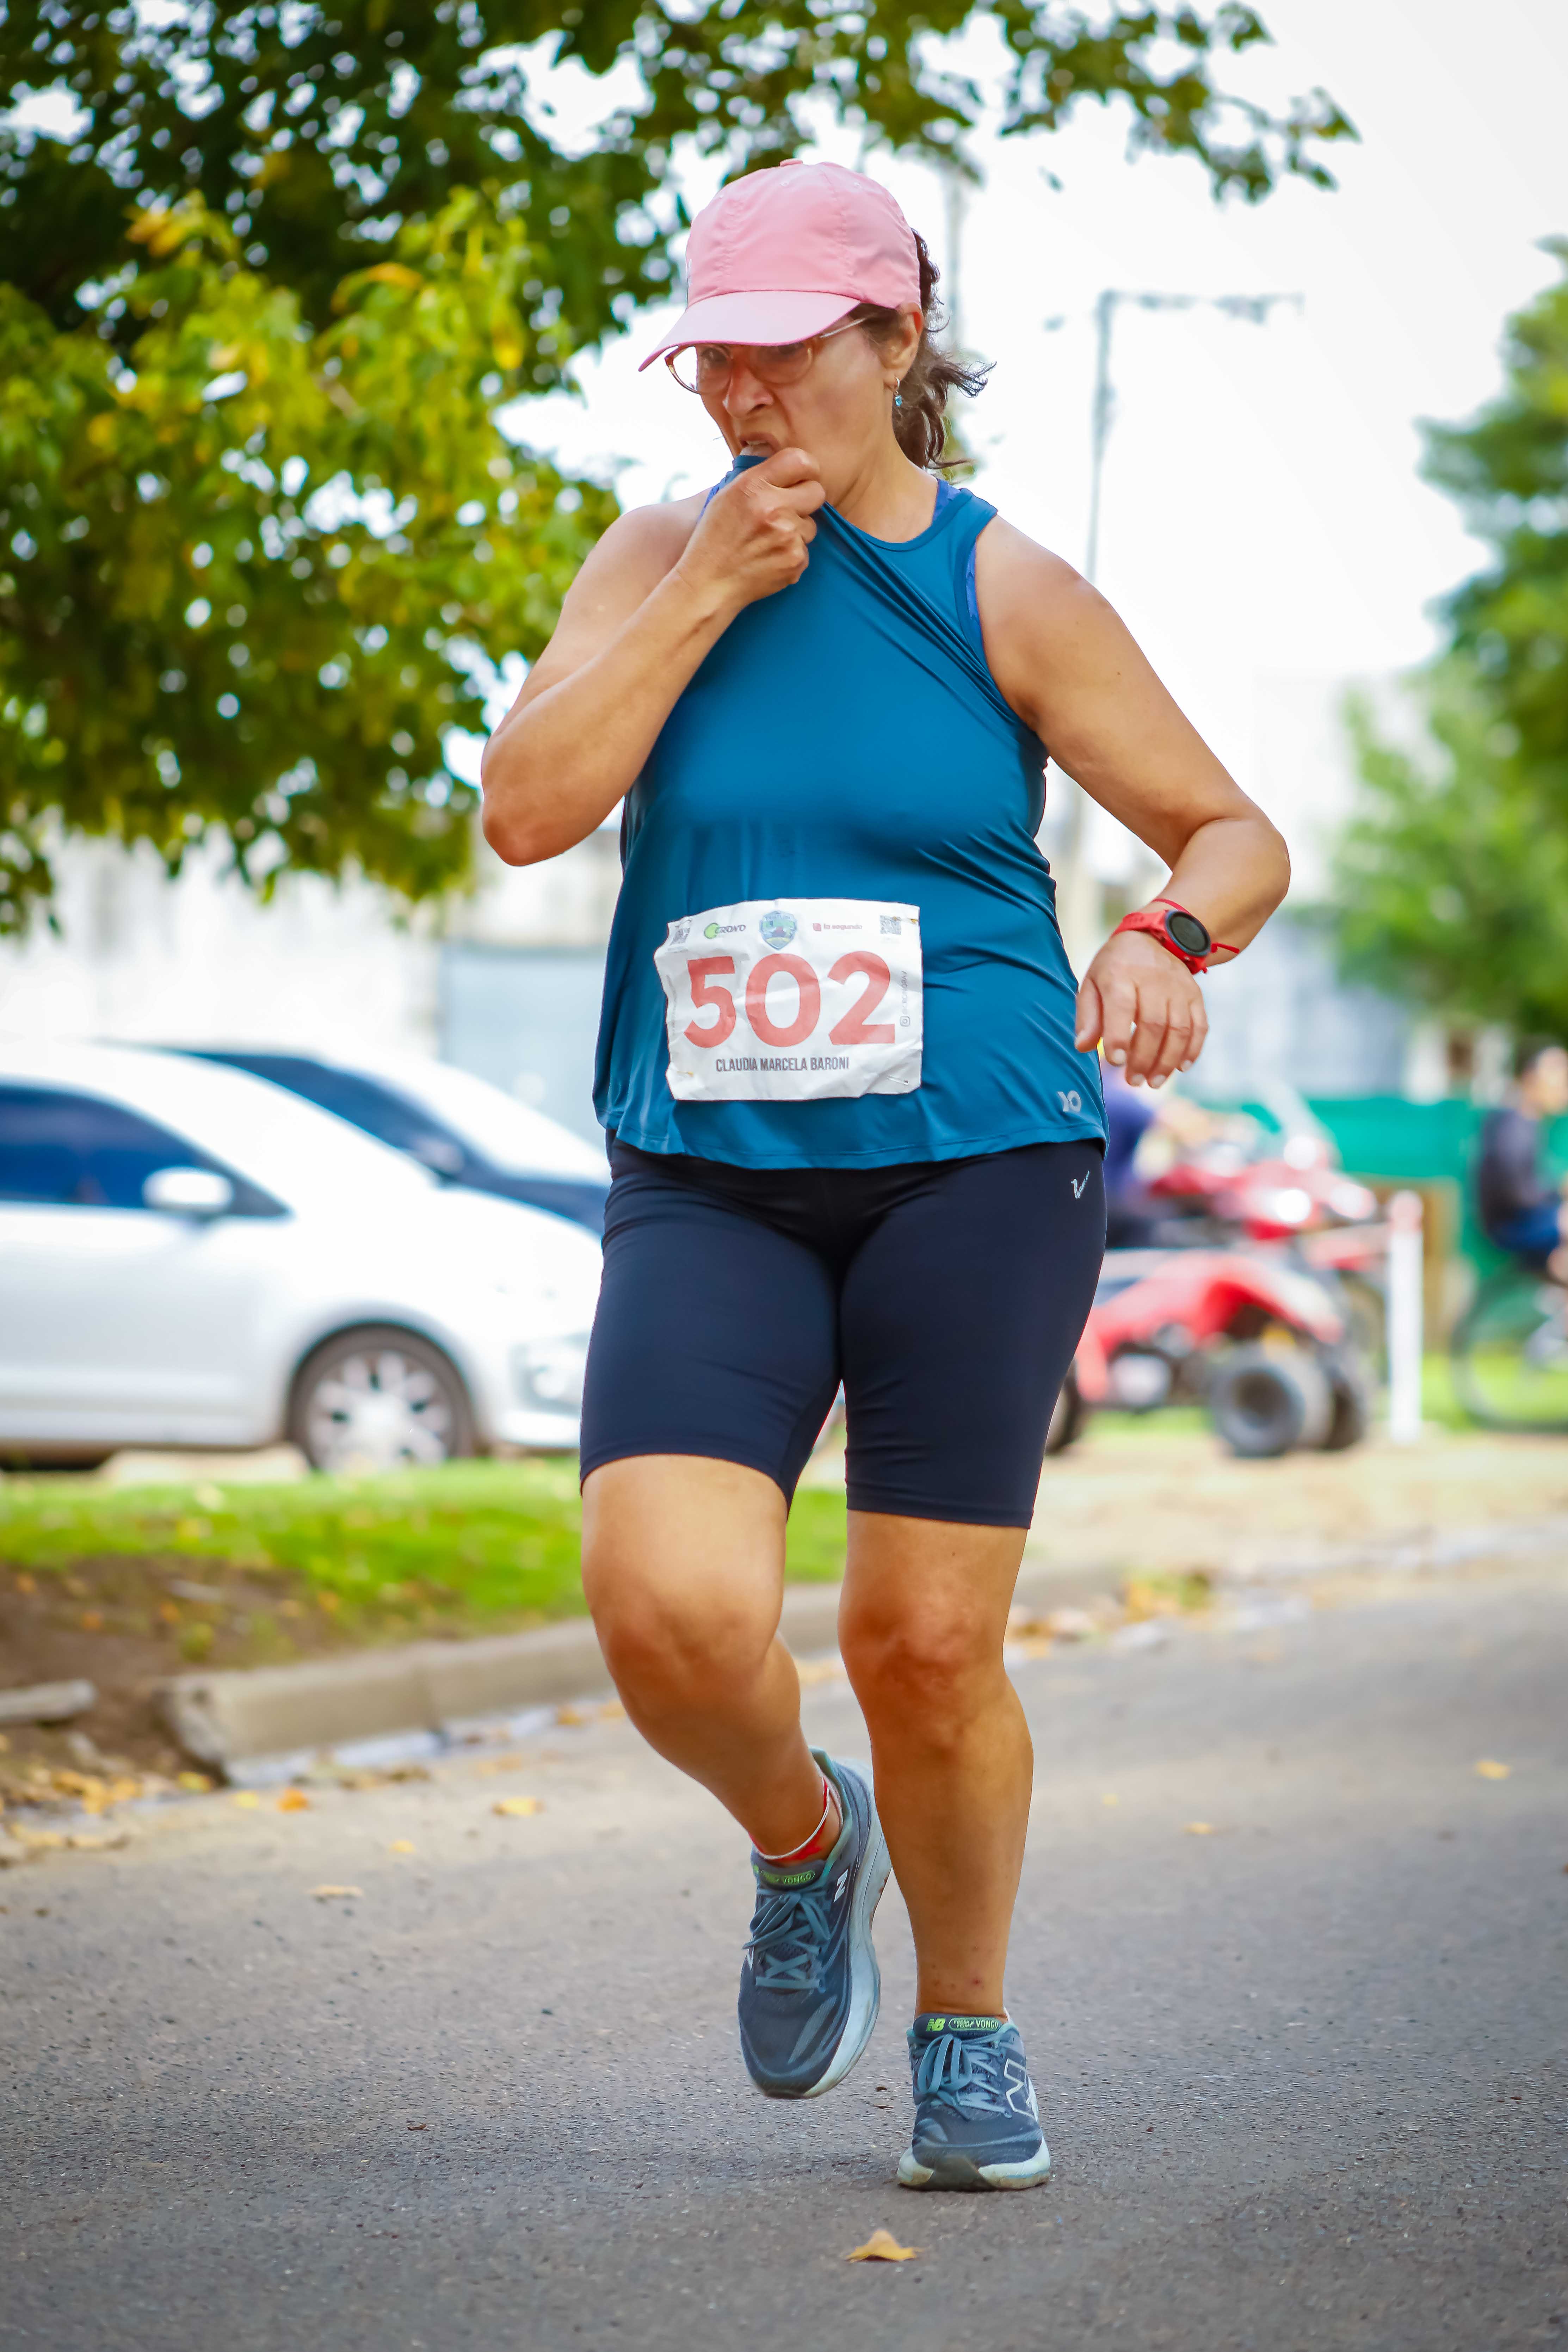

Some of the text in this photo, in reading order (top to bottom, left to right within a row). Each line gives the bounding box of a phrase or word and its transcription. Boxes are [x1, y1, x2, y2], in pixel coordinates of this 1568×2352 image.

[683, 950, 895, 1048] 502
[716, 1056, 850, 1072] CLAUDIA MARCELA BARONI
